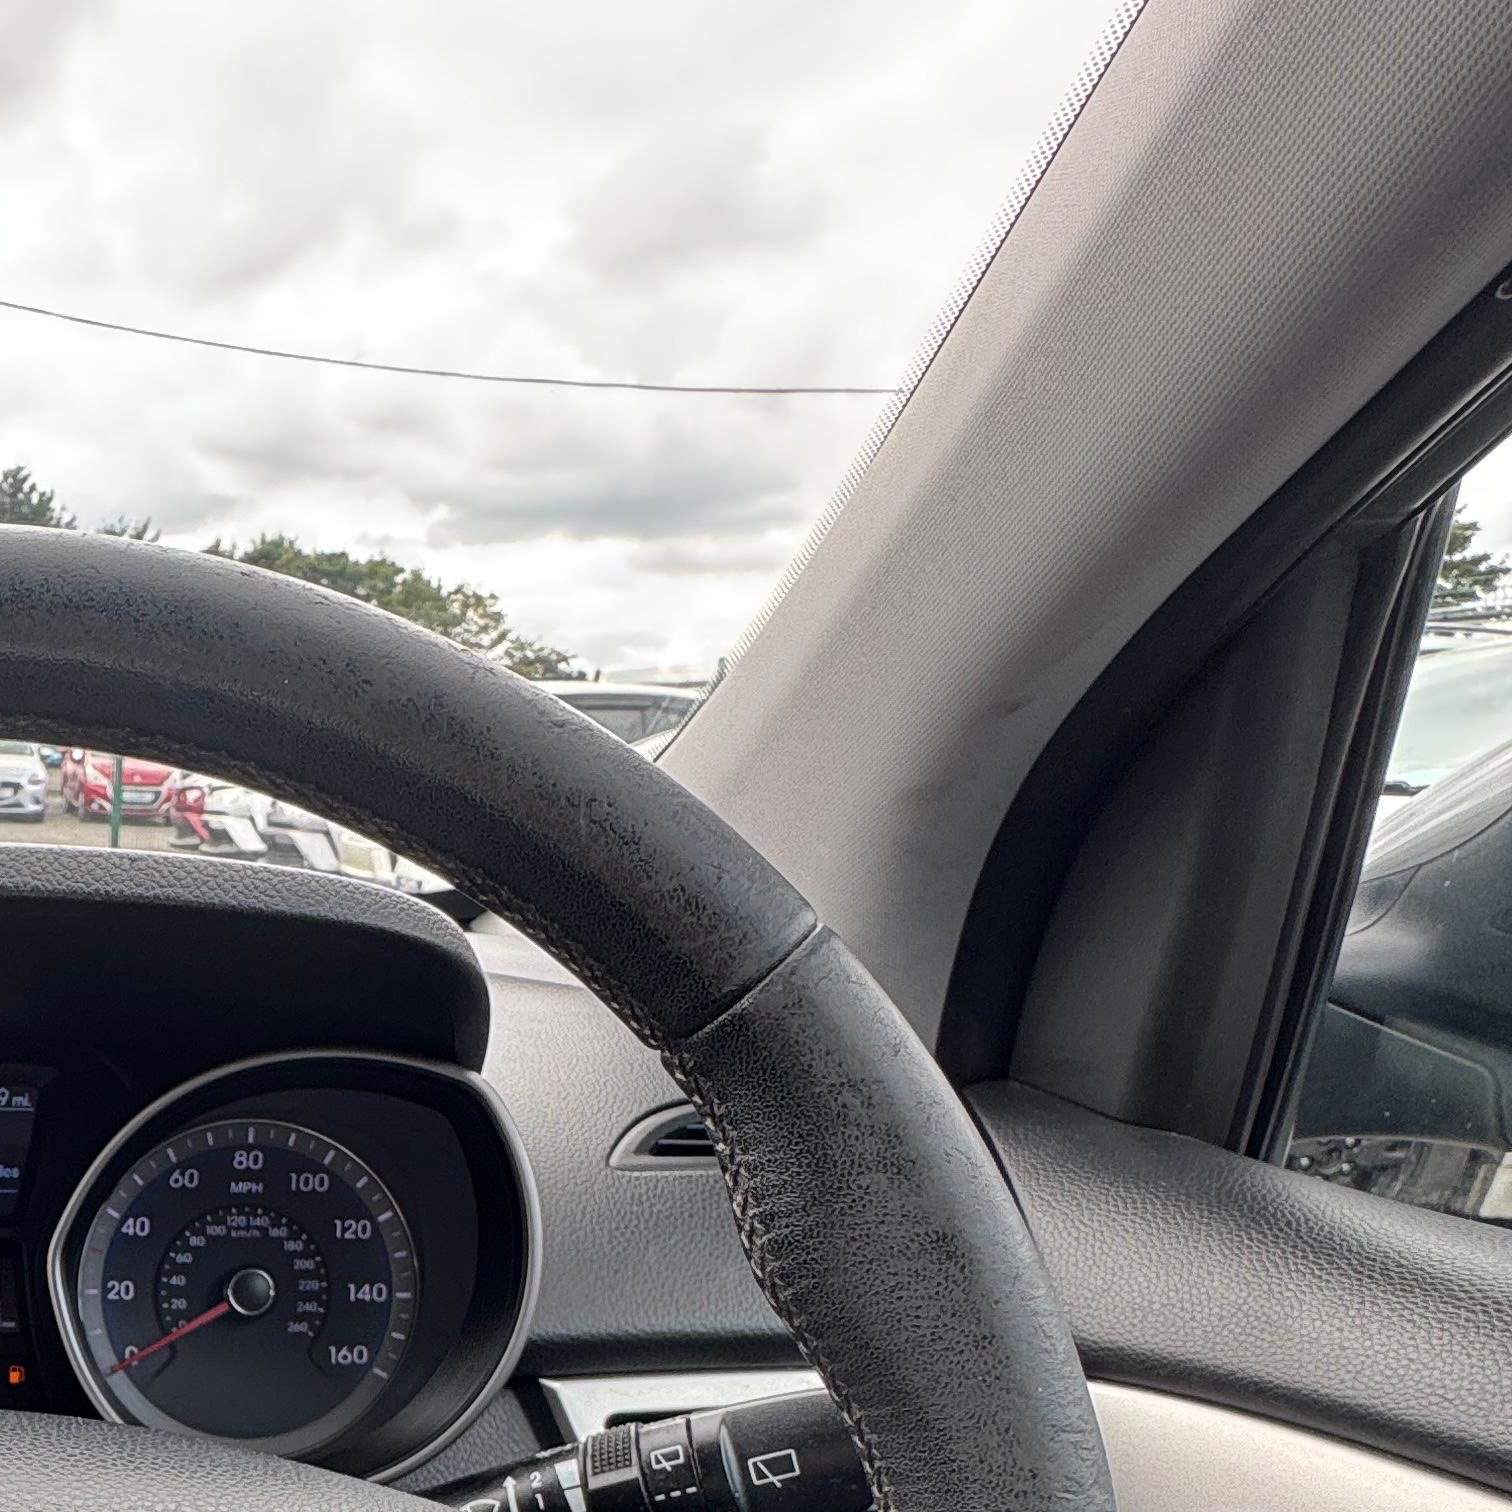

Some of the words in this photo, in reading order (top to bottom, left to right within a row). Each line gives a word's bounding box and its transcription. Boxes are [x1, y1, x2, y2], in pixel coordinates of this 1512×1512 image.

[232, 1150, 264, 1170] 80
[169, 1168, 200, 1188] 60
[289, 1172, 330, 1193] 100
[230, 1181, 263, 1194] MPH
[121, 1216, 150, 1237] 40
[227, 1215, 247, 1227] 120
[249, 1215, 270, 1227] 140
[206, 1225, 226, 1236] 100
[230, 1228, 262, 1238] km/h
[268, 1226, 288, 1237] 160
[334, 1219, 372, 1240] 120
[189, 1235, 206, 1247] 80
[283, 1240, 304, 1251] 180
[175, 1252, 193, 1264] 60
[293, 1259, 315, 1270] 200
[169, 1275, 186, 1287] 40
[298, 1279, 320, 1290] 220
[106, 1279, 135, 1301] 20
[348, 1282, 387, 1303] 140
[170, 1298, 187, 1310] 20
[296, 1301, 318, 1313] 240
[287, 1321, 309, 1333] 260
[328, 1344, 369, 1366] 160
[529, 1471, 542, 1489] 2
[534, 1493, 545, 1511] 1
